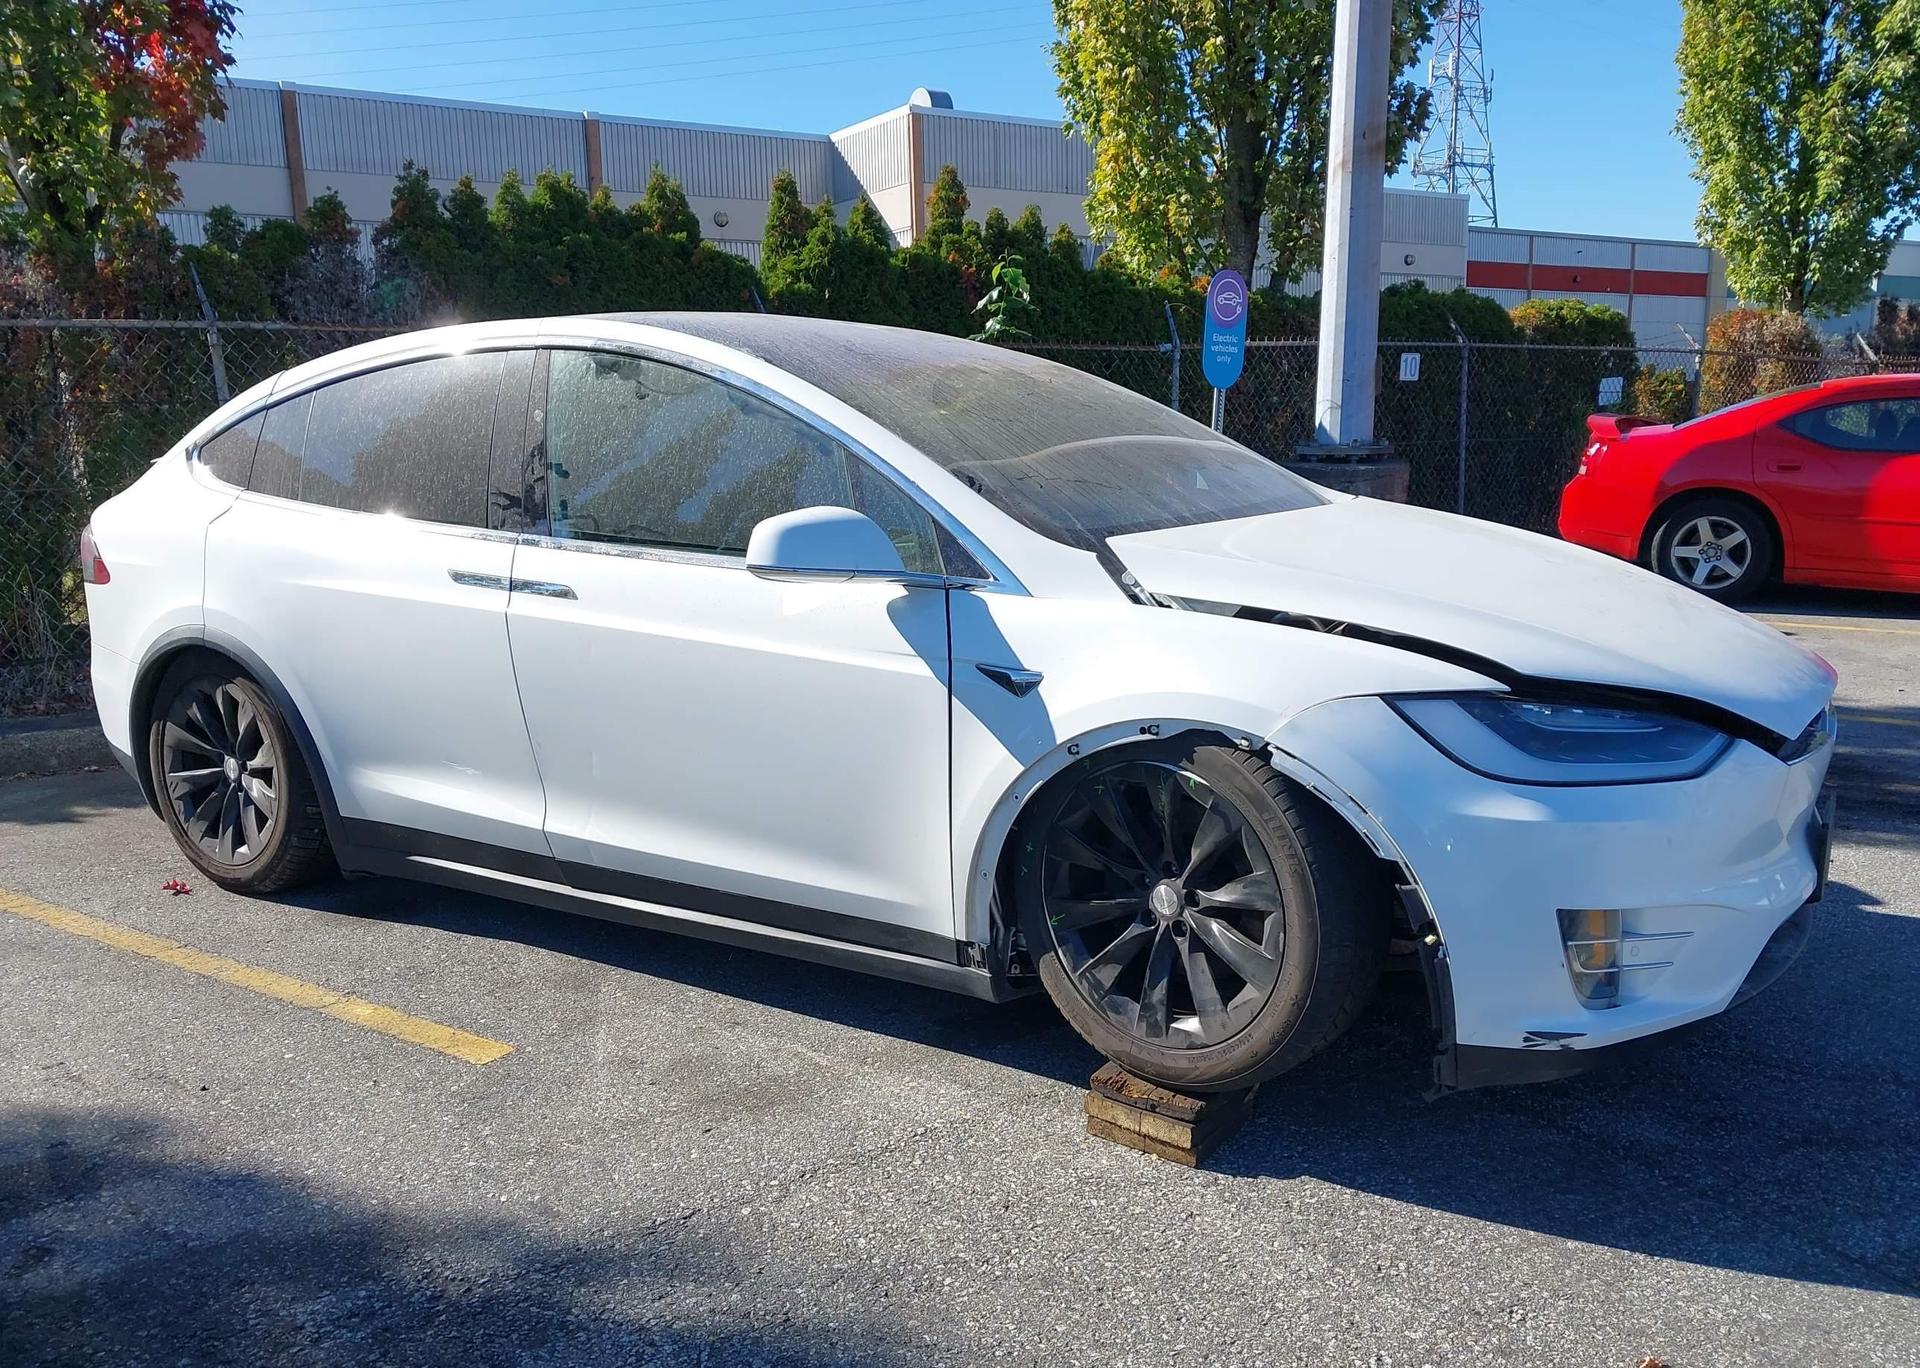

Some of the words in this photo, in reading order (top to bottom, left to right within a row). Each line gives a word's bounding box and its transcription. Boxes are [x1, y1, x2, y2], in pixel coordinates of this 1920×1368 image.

[1212, 333, 1238, 343] Electric
[1211, 343, 1238, 353] vehicles
[1216, 355, 1231, 365] only
[1403, 356, 1417, 377] 10
